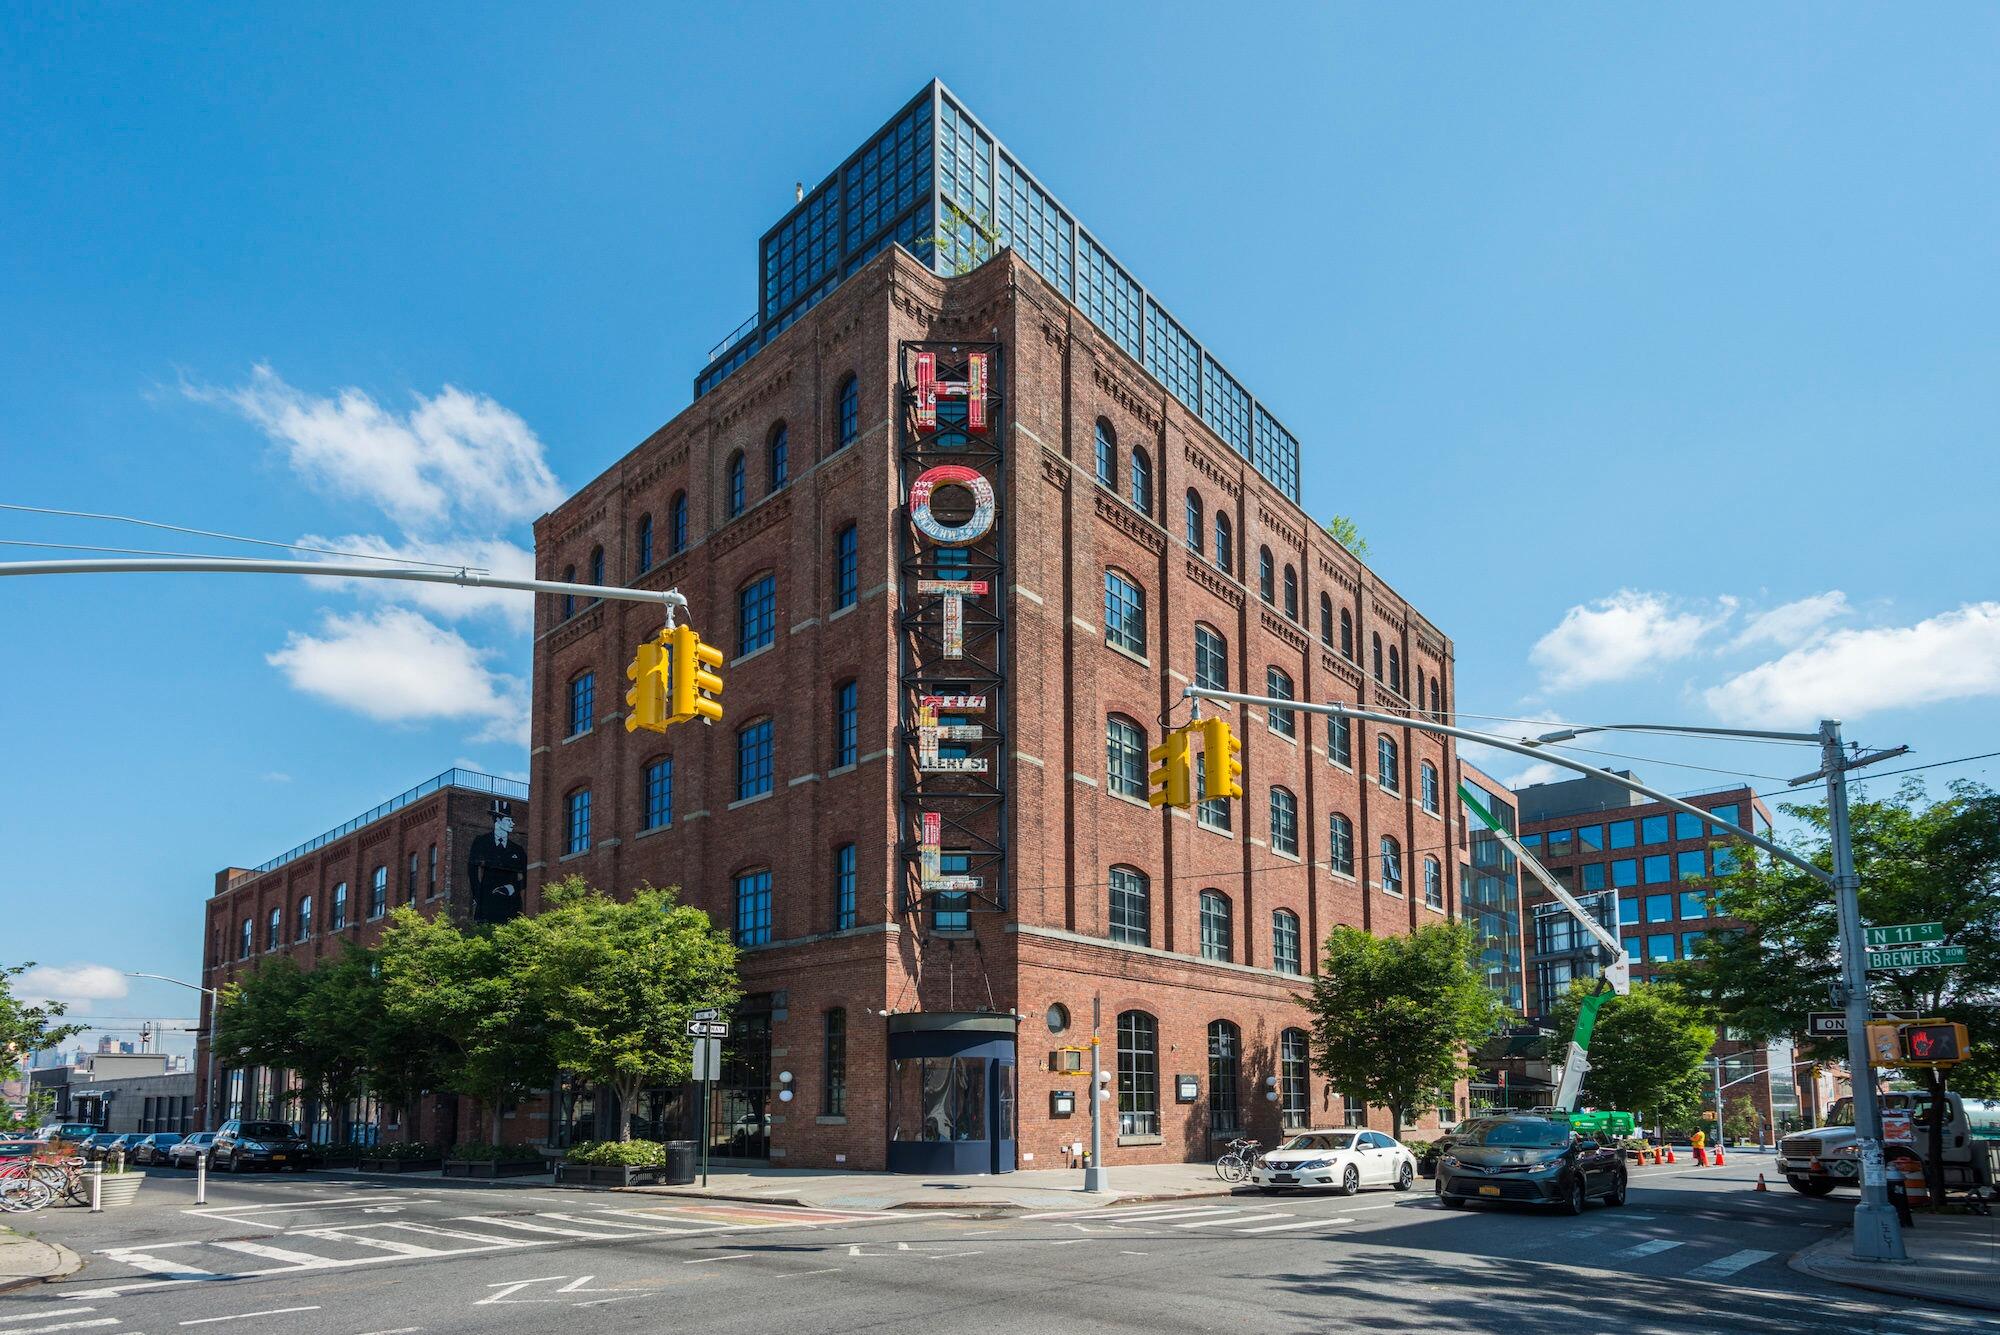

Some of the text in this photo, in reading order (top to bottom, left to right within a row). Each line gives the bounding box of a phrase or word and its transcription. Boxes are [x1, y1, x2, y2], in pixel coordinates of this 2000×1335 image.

[909, 352, 995, 891] HOTEL
[1874, 925, 1933, 944] N 11 St
[1872, 949, 1942, 967] BREWERS
[1945, 948, 1964, 957] ROW
[1824, 1020, 1845, 1029] ON
